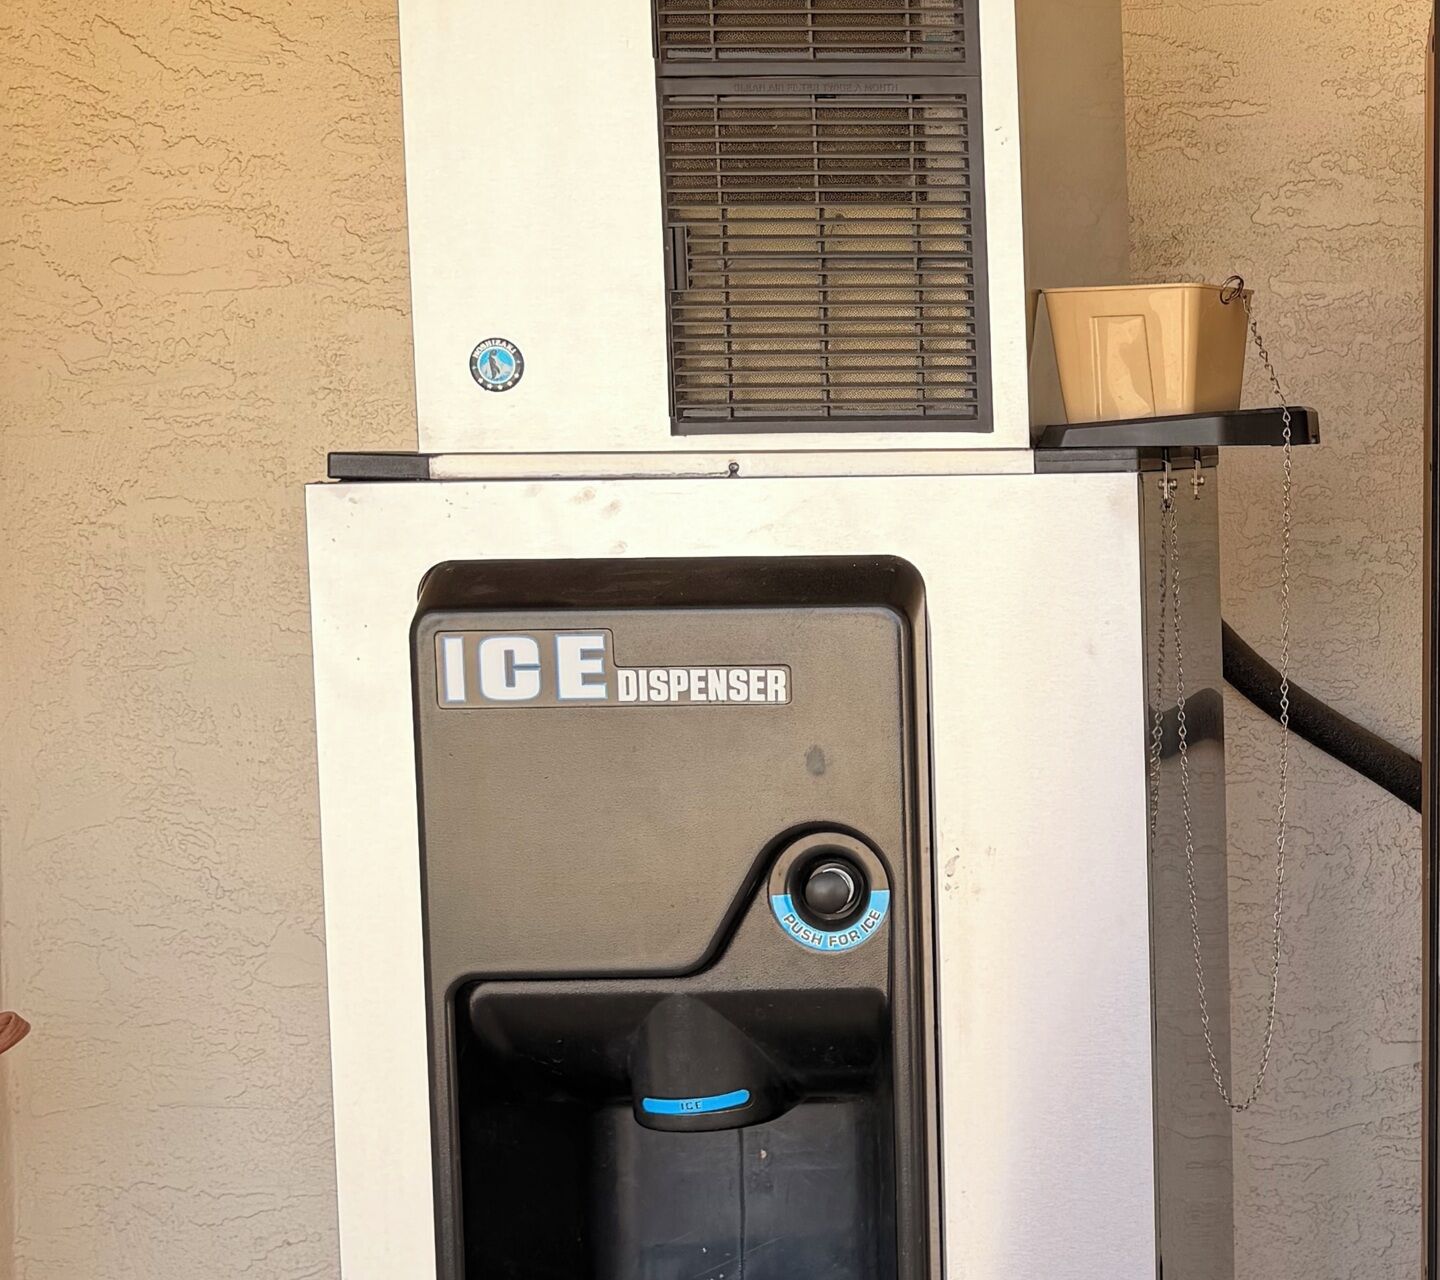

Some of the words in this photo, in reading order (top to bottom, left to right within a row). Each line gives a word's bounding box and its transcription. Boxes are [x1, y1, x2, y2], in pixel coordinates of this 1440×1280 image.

[472, 339, 518, 359] HOSHIZAKI
[441, 632, 609, 704] ICE
[617, 667, 788, 704] DISPENSER
[784, 913, 823, 946] PUSH
[828, 929, 861, 947] FOR
[860, 910, 881, 933] ICE
[680, 1101, 702, 1110] ICE
